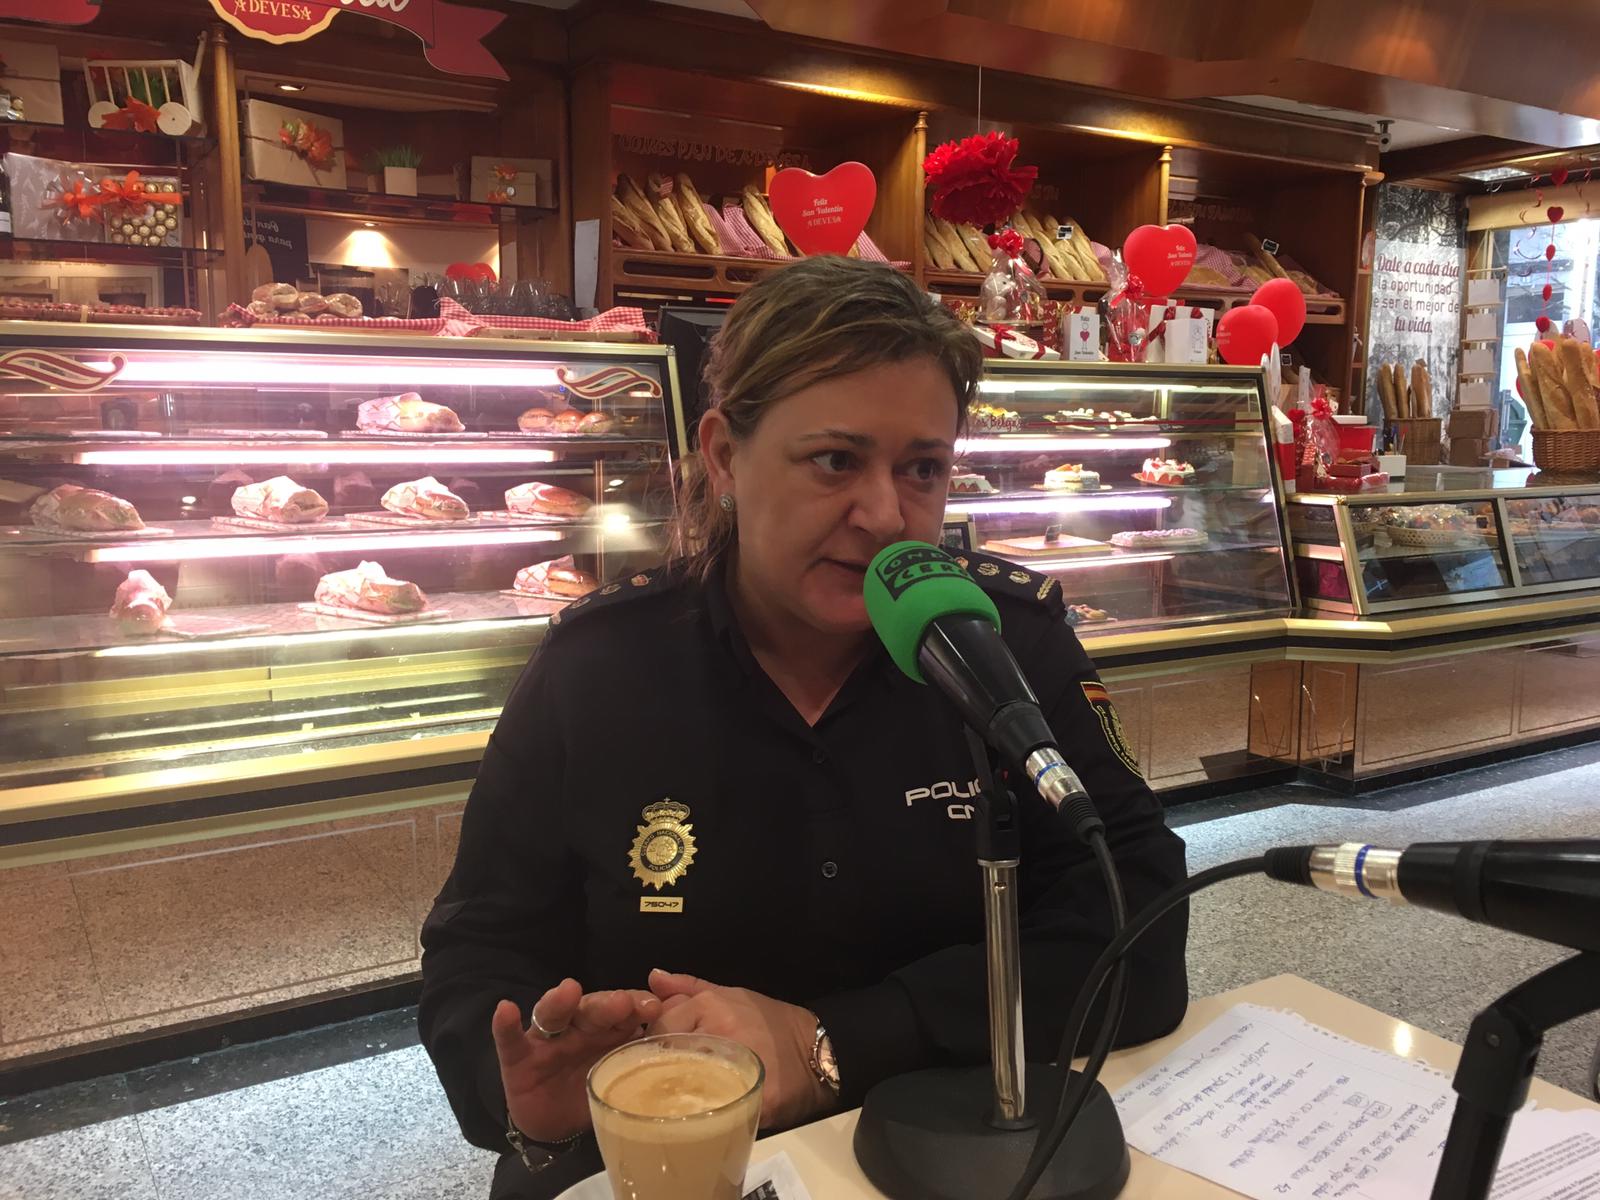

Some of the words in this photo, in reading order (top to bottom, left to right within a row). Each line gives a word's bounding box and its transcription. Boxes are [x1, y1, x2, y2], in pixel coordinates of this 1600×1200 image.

[1377, 254, 1402, 273] Dale
[1404, 261, 1412, 274] a
[1413, 260, 1440, 277] cada
[1378, 277, 1388, 290] la
[1391, 279, 1452, 295] oportunidad
[1382, 298, 1401, 309] ser
[1403, 297, 1413, 310] el
[1416, 300, 1446, 315] mejor
[1448, 299, 1460, 313] de
[1394, 316, 1406, 332] tu
